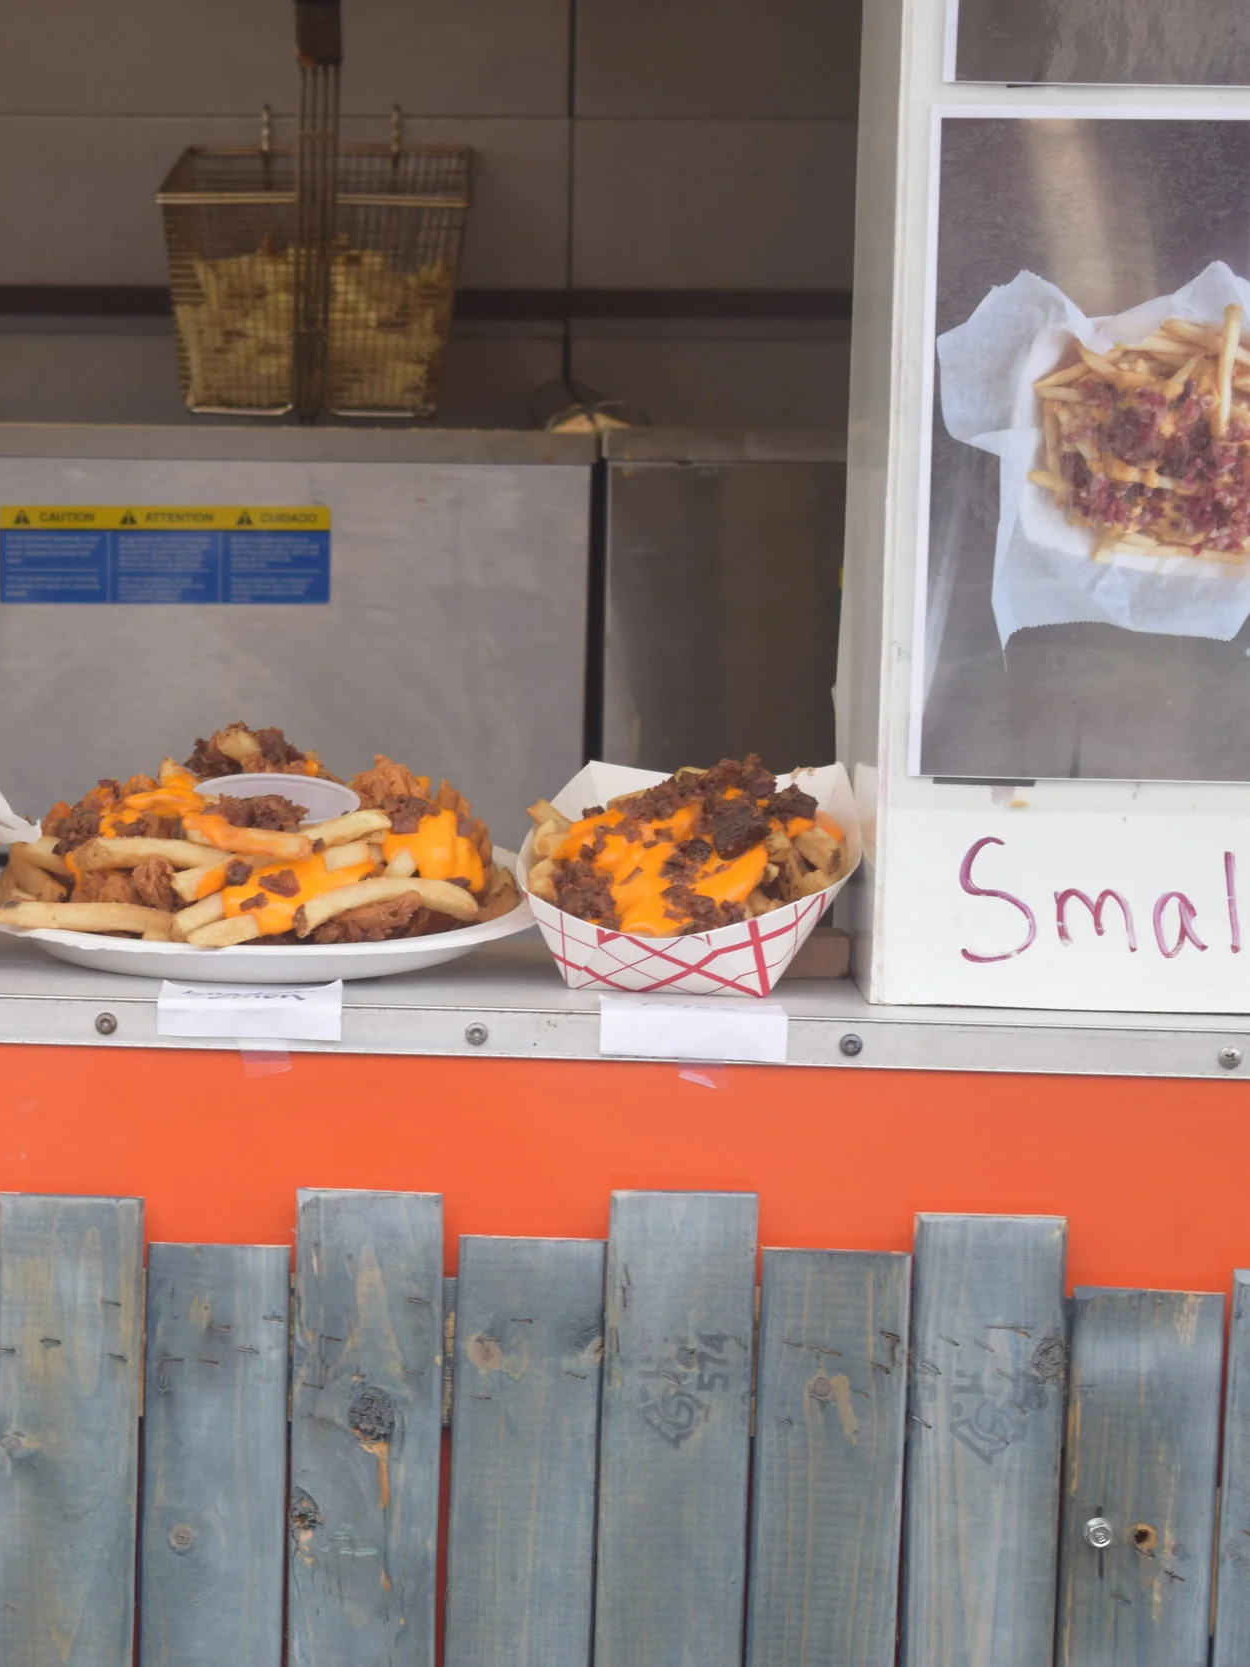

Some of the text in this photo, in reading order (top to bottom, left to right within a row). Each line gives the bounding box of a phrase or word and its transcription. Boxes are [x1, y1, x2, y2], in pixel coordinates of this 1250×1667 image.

[40, 511, 95, 523] CAUTION
[145, 511, 214, 523] ATTENTION
[259, 512, 318, 524] CUIDADO
[959, 836, 1241, 963] Smal
